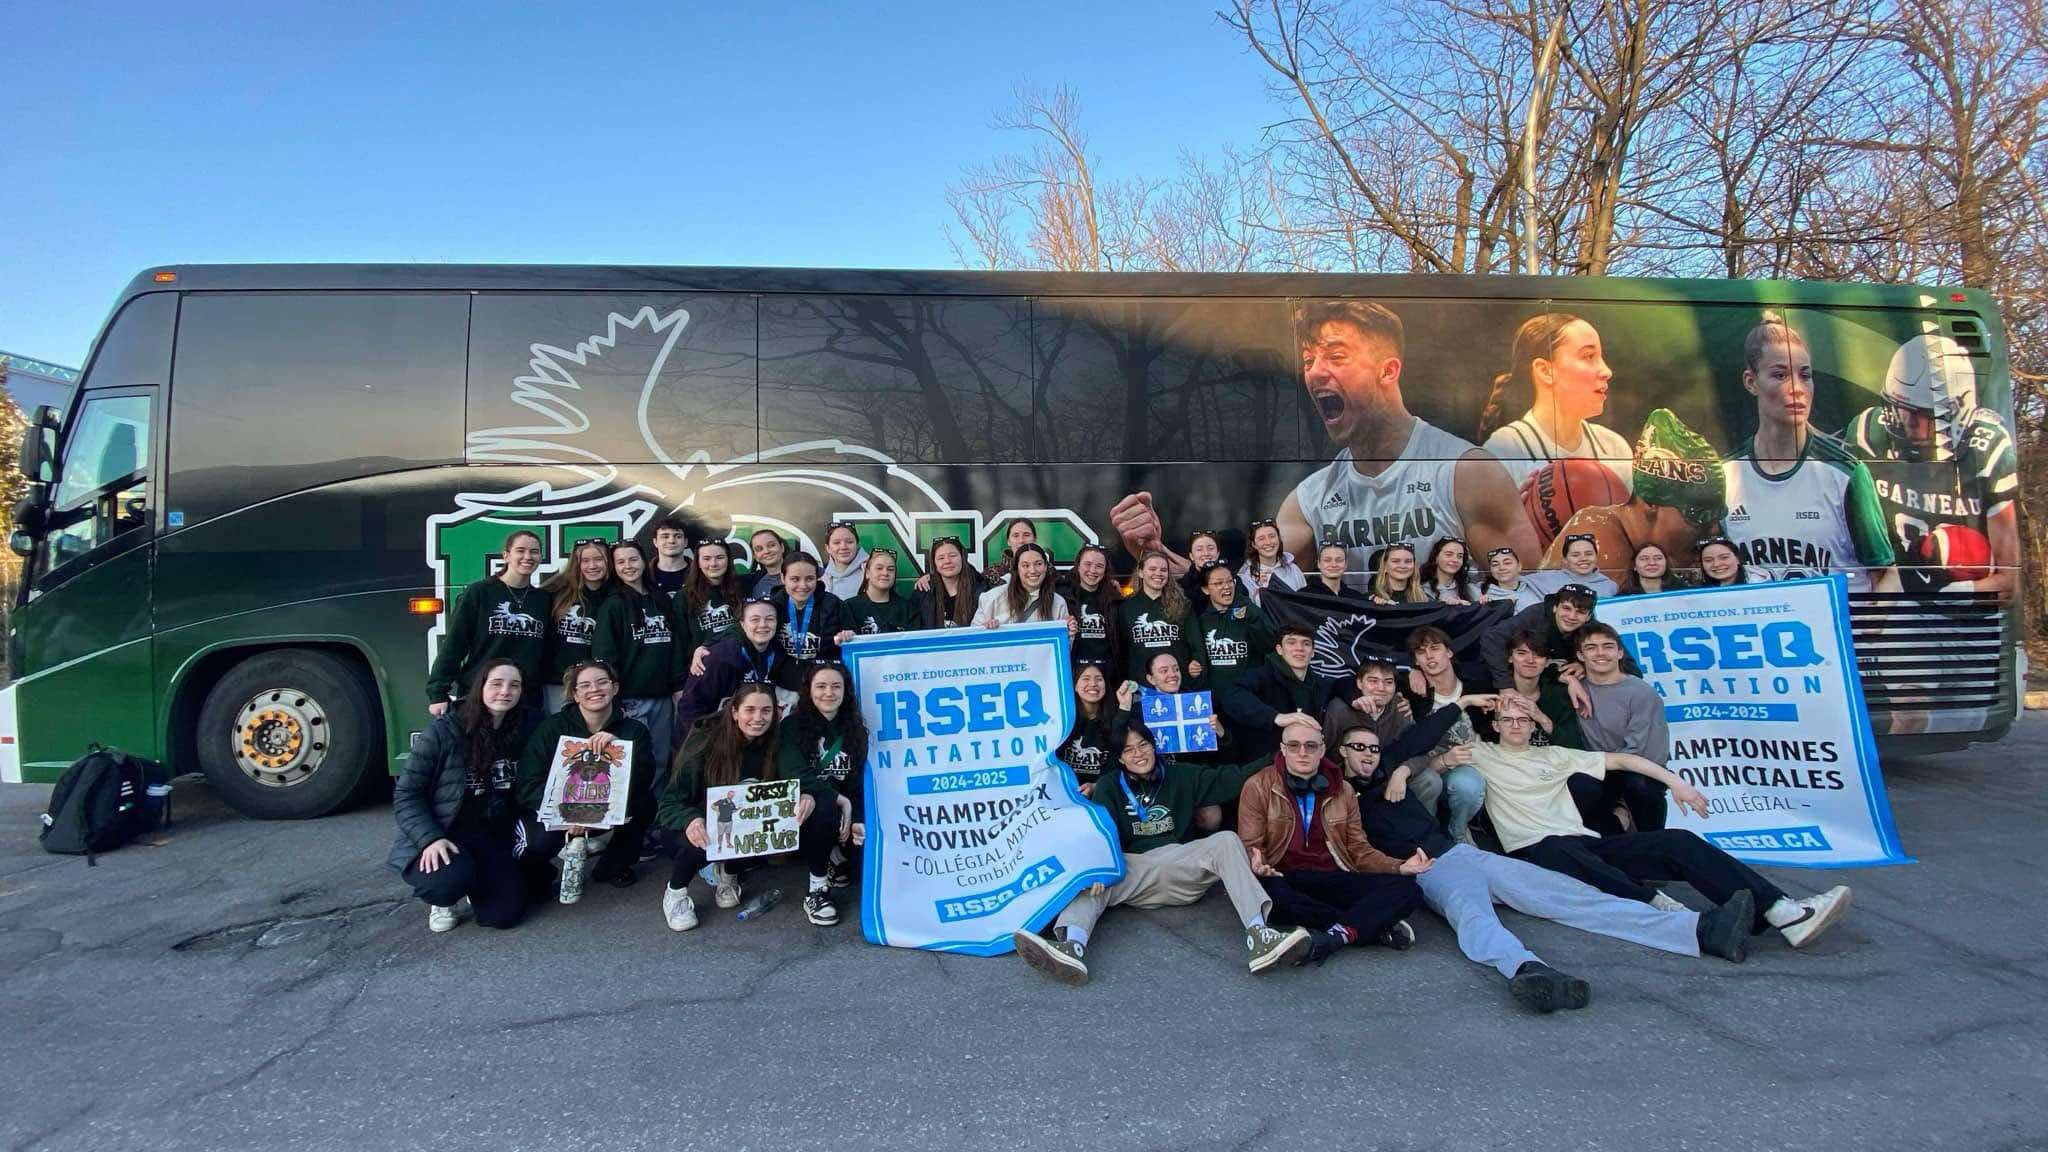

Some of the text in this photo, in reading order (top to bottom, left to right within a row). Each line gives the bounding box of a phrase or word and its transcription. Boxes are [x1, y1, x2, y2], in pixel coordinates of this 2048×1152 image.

[1406, 480, 1432, 494] REQ
[1876, 479, 1983, 516] GARNEAU
[1796, 511, 1820, 520] RSEQ
[1738, 537, 1831, 576] ARNEAU
[1621, 615, 1661, 626] SPORT.
[1664, 609, 1739, 623] ÉDUCATION.
[1132, 624, 1180, 640] ELANS
[1619, 621, 1825, 674] RSEQ
[883, 672, 920, 683] SPORT.
[1653, 675, 1821, 699] ATATION
[875, 680, 1051, 742] RSEQ
[1683, 704, 1769, 720] 2024-2025
[878, 735, 1048, 769] NATATION
[1669, 738, 1838, 763] AMPIONNES
[931, 770, 1008, 791] 2024-2025
[1678, 765, 1845, 791] OVINCIALES
[914, 847, 1006, 876] COLLÉGIAL
